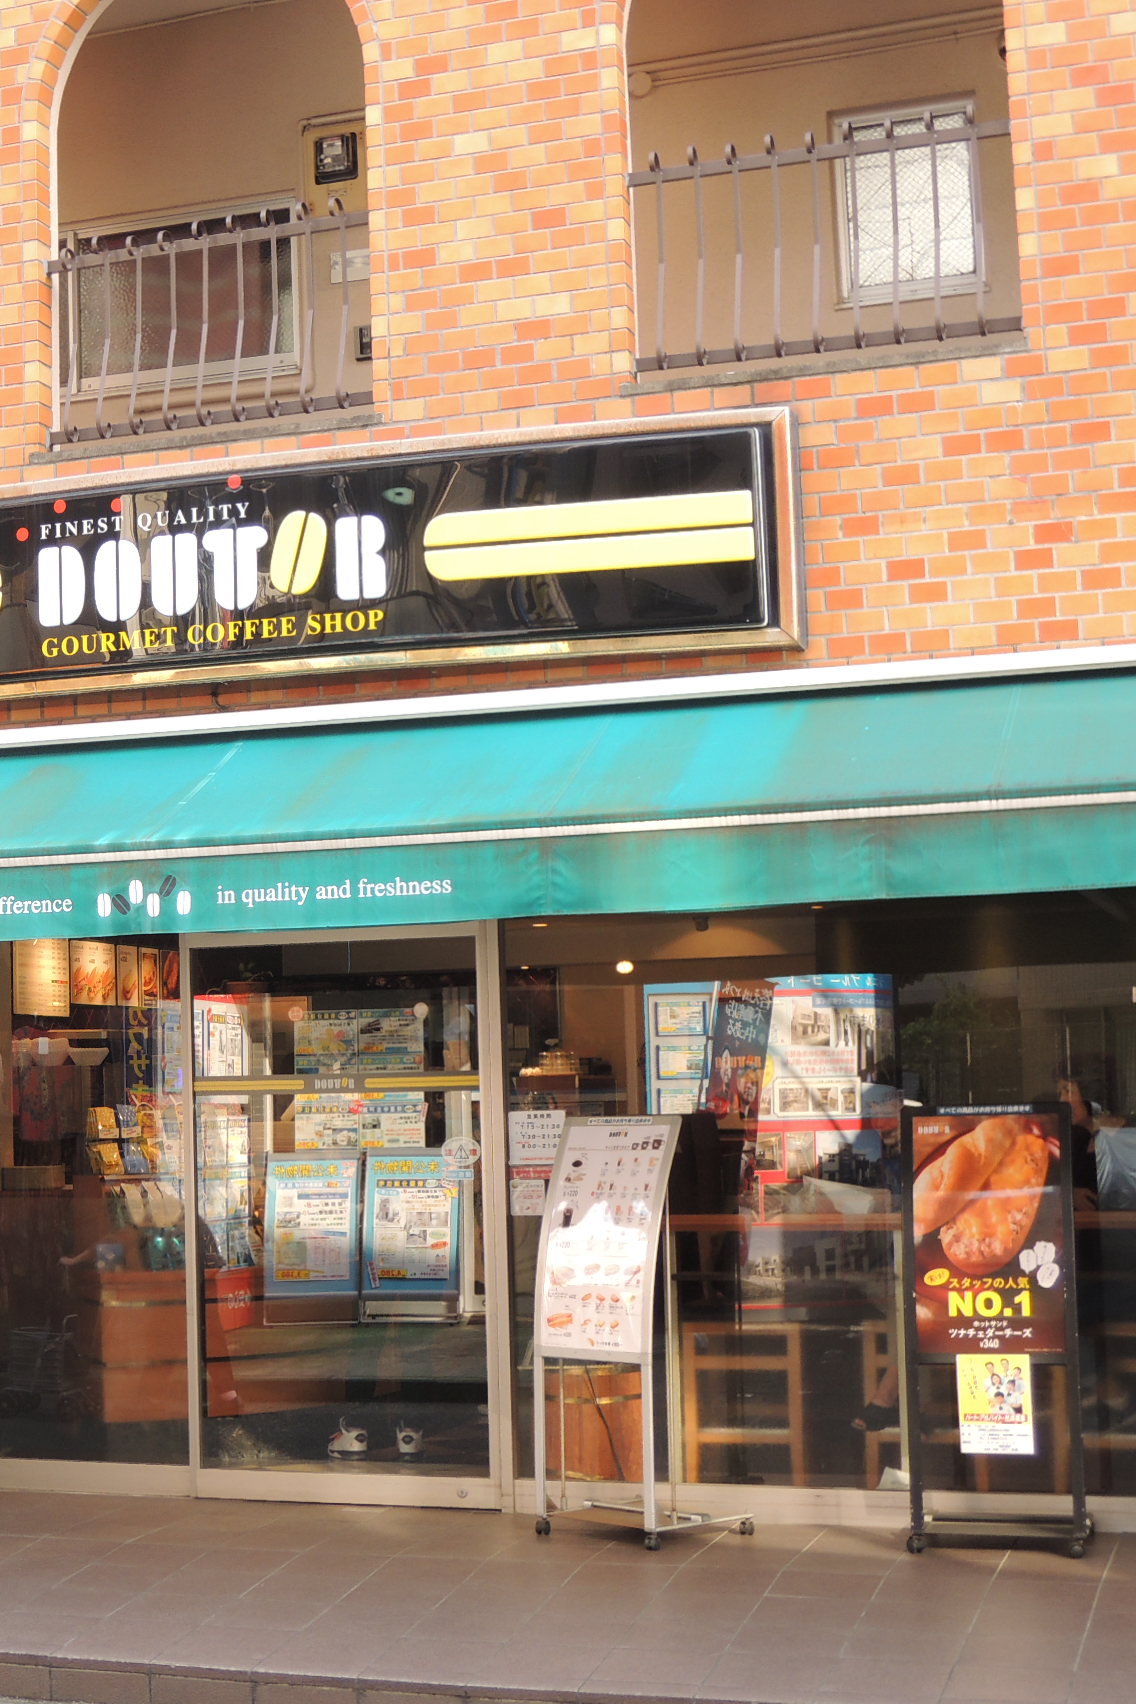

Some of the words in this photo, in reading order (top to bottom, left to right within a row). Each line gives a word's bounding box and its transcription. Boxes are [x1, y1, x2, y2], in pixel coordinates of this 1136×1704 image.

[39, 516, 123, 540] FINEST
[137, 502, 250, 530] QUALITY
[37, 509, 387, 628] DOUTOR
[41, 626, 177, 658] GOURMET
[187, 616, 297, 645] COFFEE
[307, 609, 385, 635] SHOP
[216, 885, 236, 904] in
[241, 881, 309, 908] quality
[315, 880, 351, 900] and
[357, 877, 452, 898] freshness
[314, 1077, 355, 1090] DOUTOR
[948, 1276, 1030, 1289] スタッフの人気
[948, 1290, 1033, 1318] NO.1
[948, 1328, 1033, 1338] ツナチェダーチーズ
[972, 1320, 1008, 1328] ホットサンド
[979, 1338, 1000, 1349] ¥340
